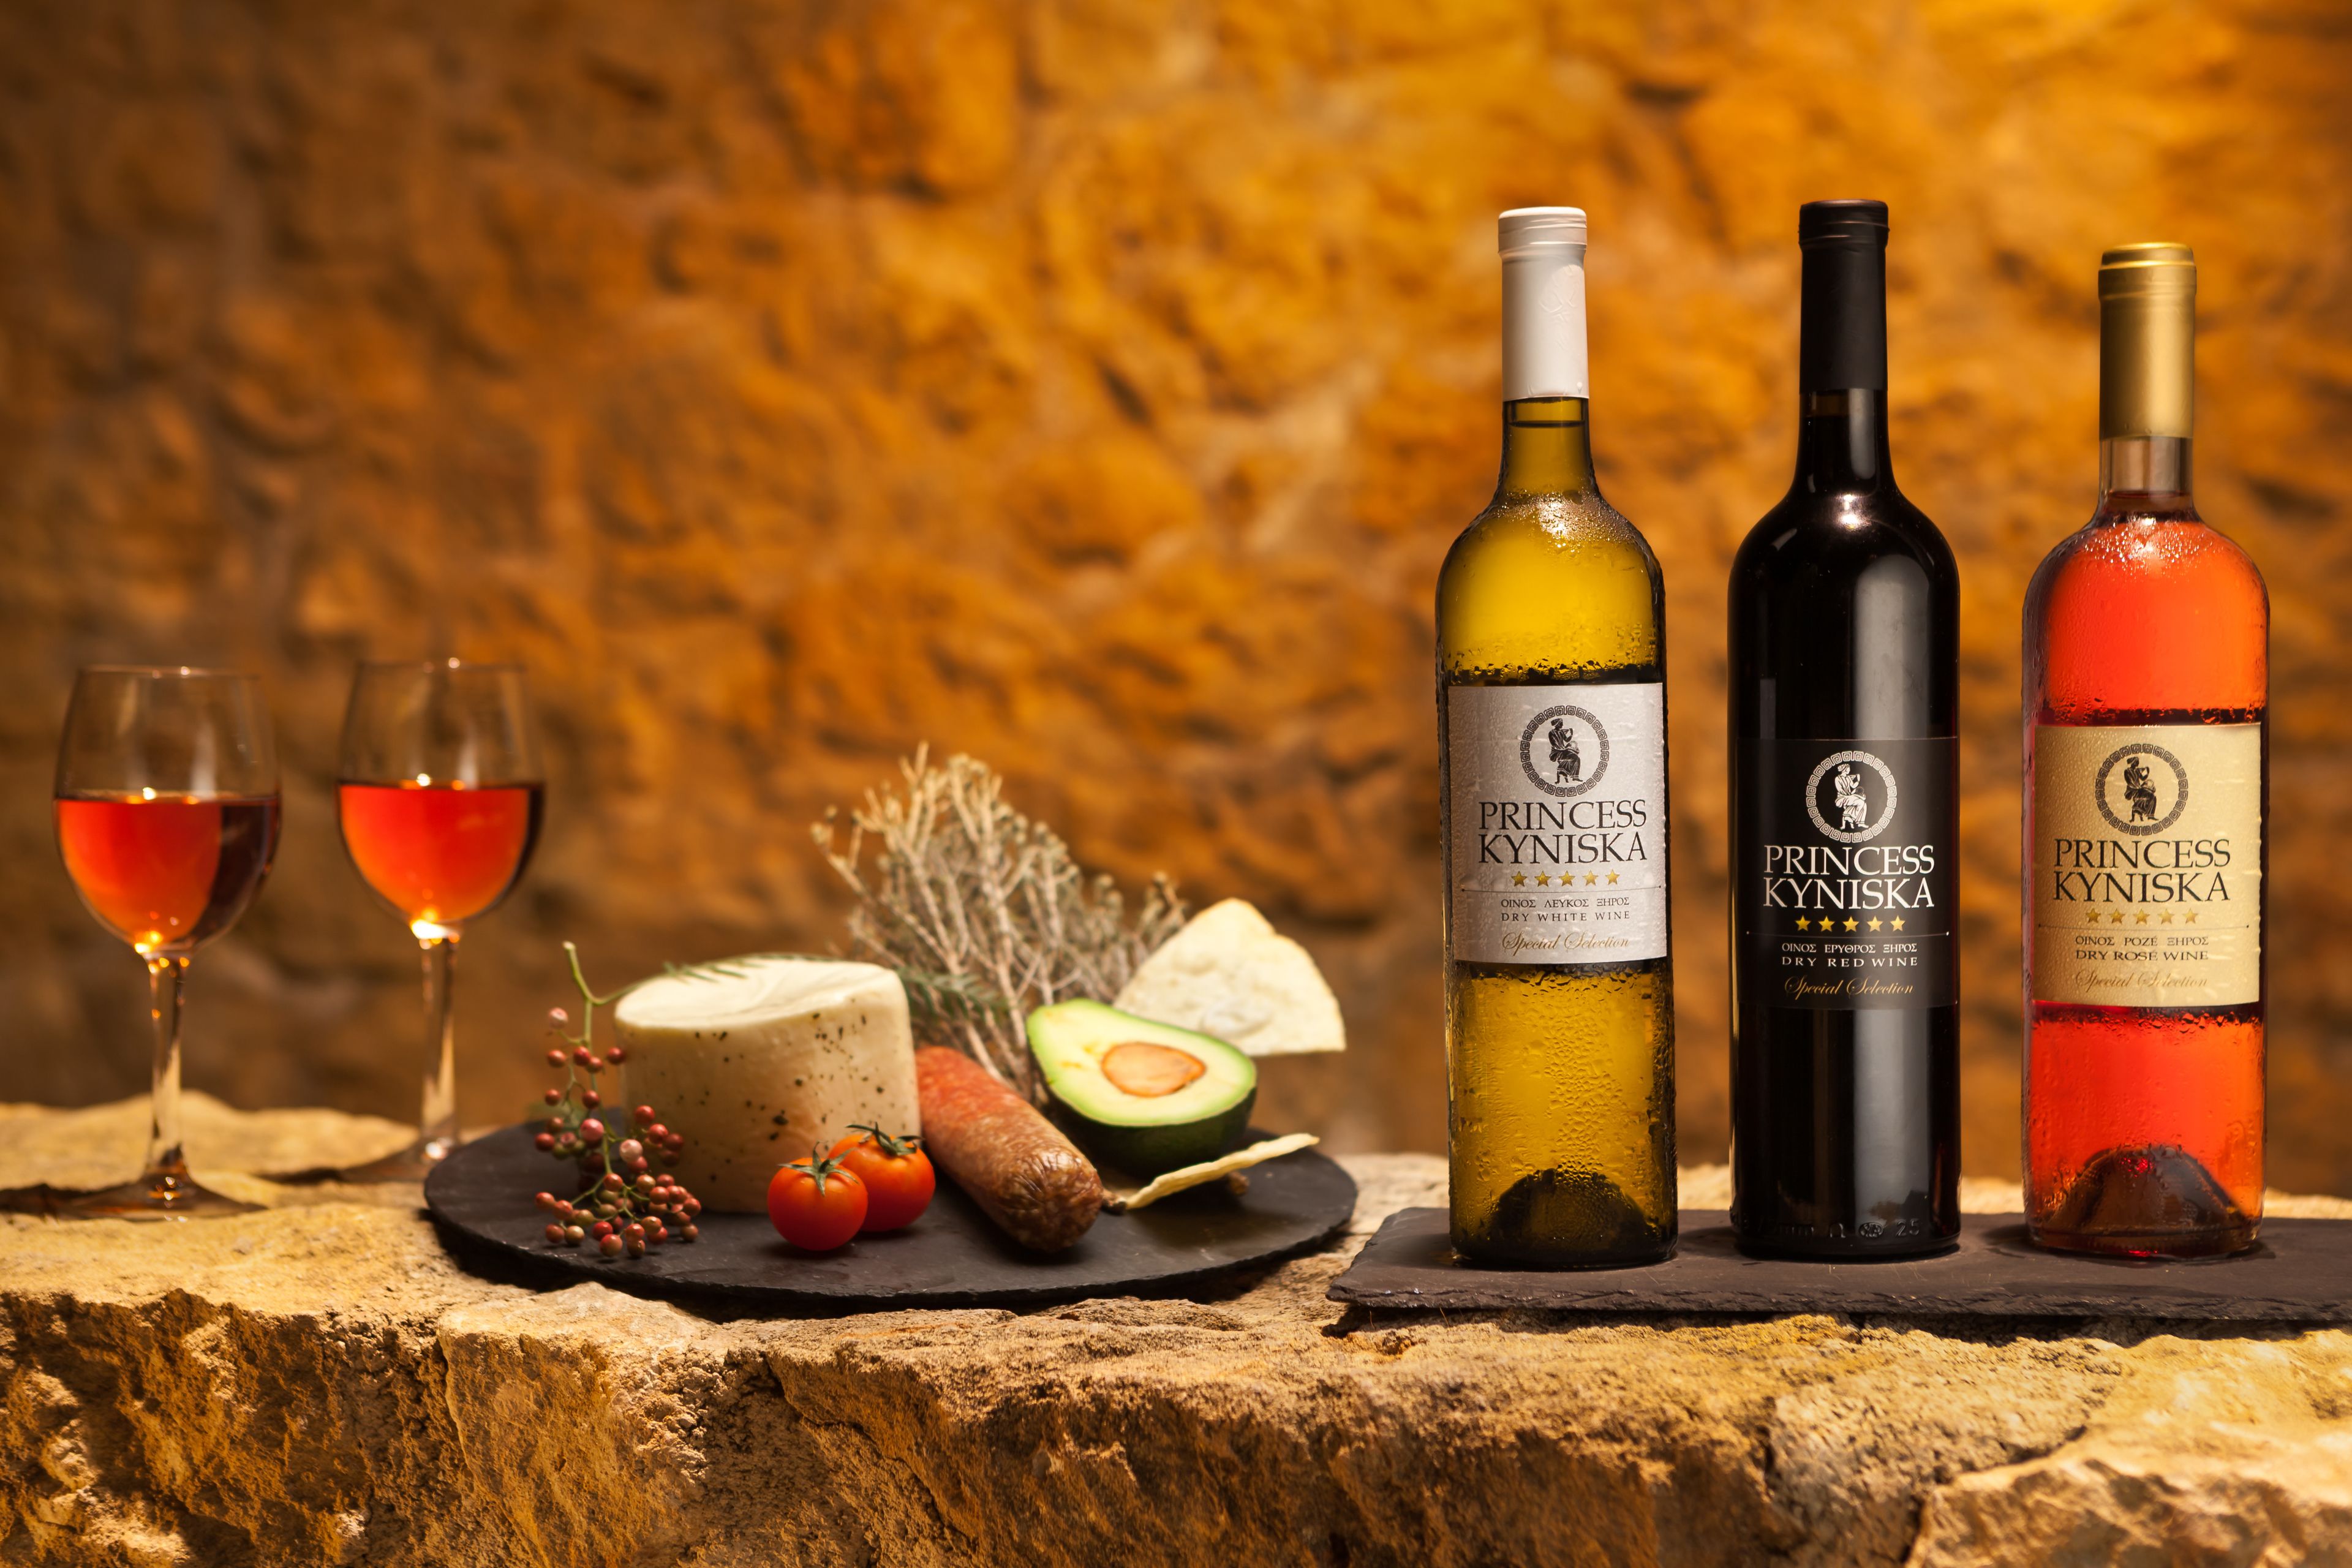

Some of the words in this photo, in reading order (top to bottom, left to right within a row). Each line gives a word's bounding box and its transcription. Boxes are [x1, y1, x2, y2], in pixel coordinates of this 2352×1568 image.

[1479, 799, 1647, 830] PRINCESS
[1479, 832, 1648, 864] KYNISKA
[1763, 845, 1935, 875] PRINCESS
[2054, 838, 2231, 869] PRINCESS
[1763, 876, 1935, 910] KYNISKA
[2053, 871, 2231, 903] KYNISKA
[1501, 899, 1536, 908] ΟΙΝΟΣ
[1544, 899, 1589, 908] ΛΕΥΚΟΣ
[1596, 897, 1630, 907] ΞΗΡΟΣ
[1501, 913, 1529, 921] DRY
[1537, 913, 1588, 921] WHITE
[1595, 911, 1630, 921] WINE
[1502, 931, 1561, 957] Special
[1564, 931, 1630, 953] Selection
[1782, 943, 1817, 952] ΟΙΝΟΣ
[1825, 944, 1876, 954] ΕΡΥΘΡΟΣ
[1883, 943, 1918, 953] ΞΗΡΟΣ
[2075, 935, 2115, 946] ΟΙΝΟΣ
[2167, 936, 2209, 946] ΞΗΡΟΣ
[1782, 956, 1817, 966] DRY
[1828, 958, 1864, 967] RED
[1872, 957, 1918, 967] WINE
[2076, 950, 2108, 960] DRY
[2163, 951, 2209, 960] WINE
[1784, 975, 1844, 1000] Special
[1846, 975, 1914, 1000] Selection
[2075, 968, 2135, 993] Special
[2137, 970, 2208, 987] Selection
